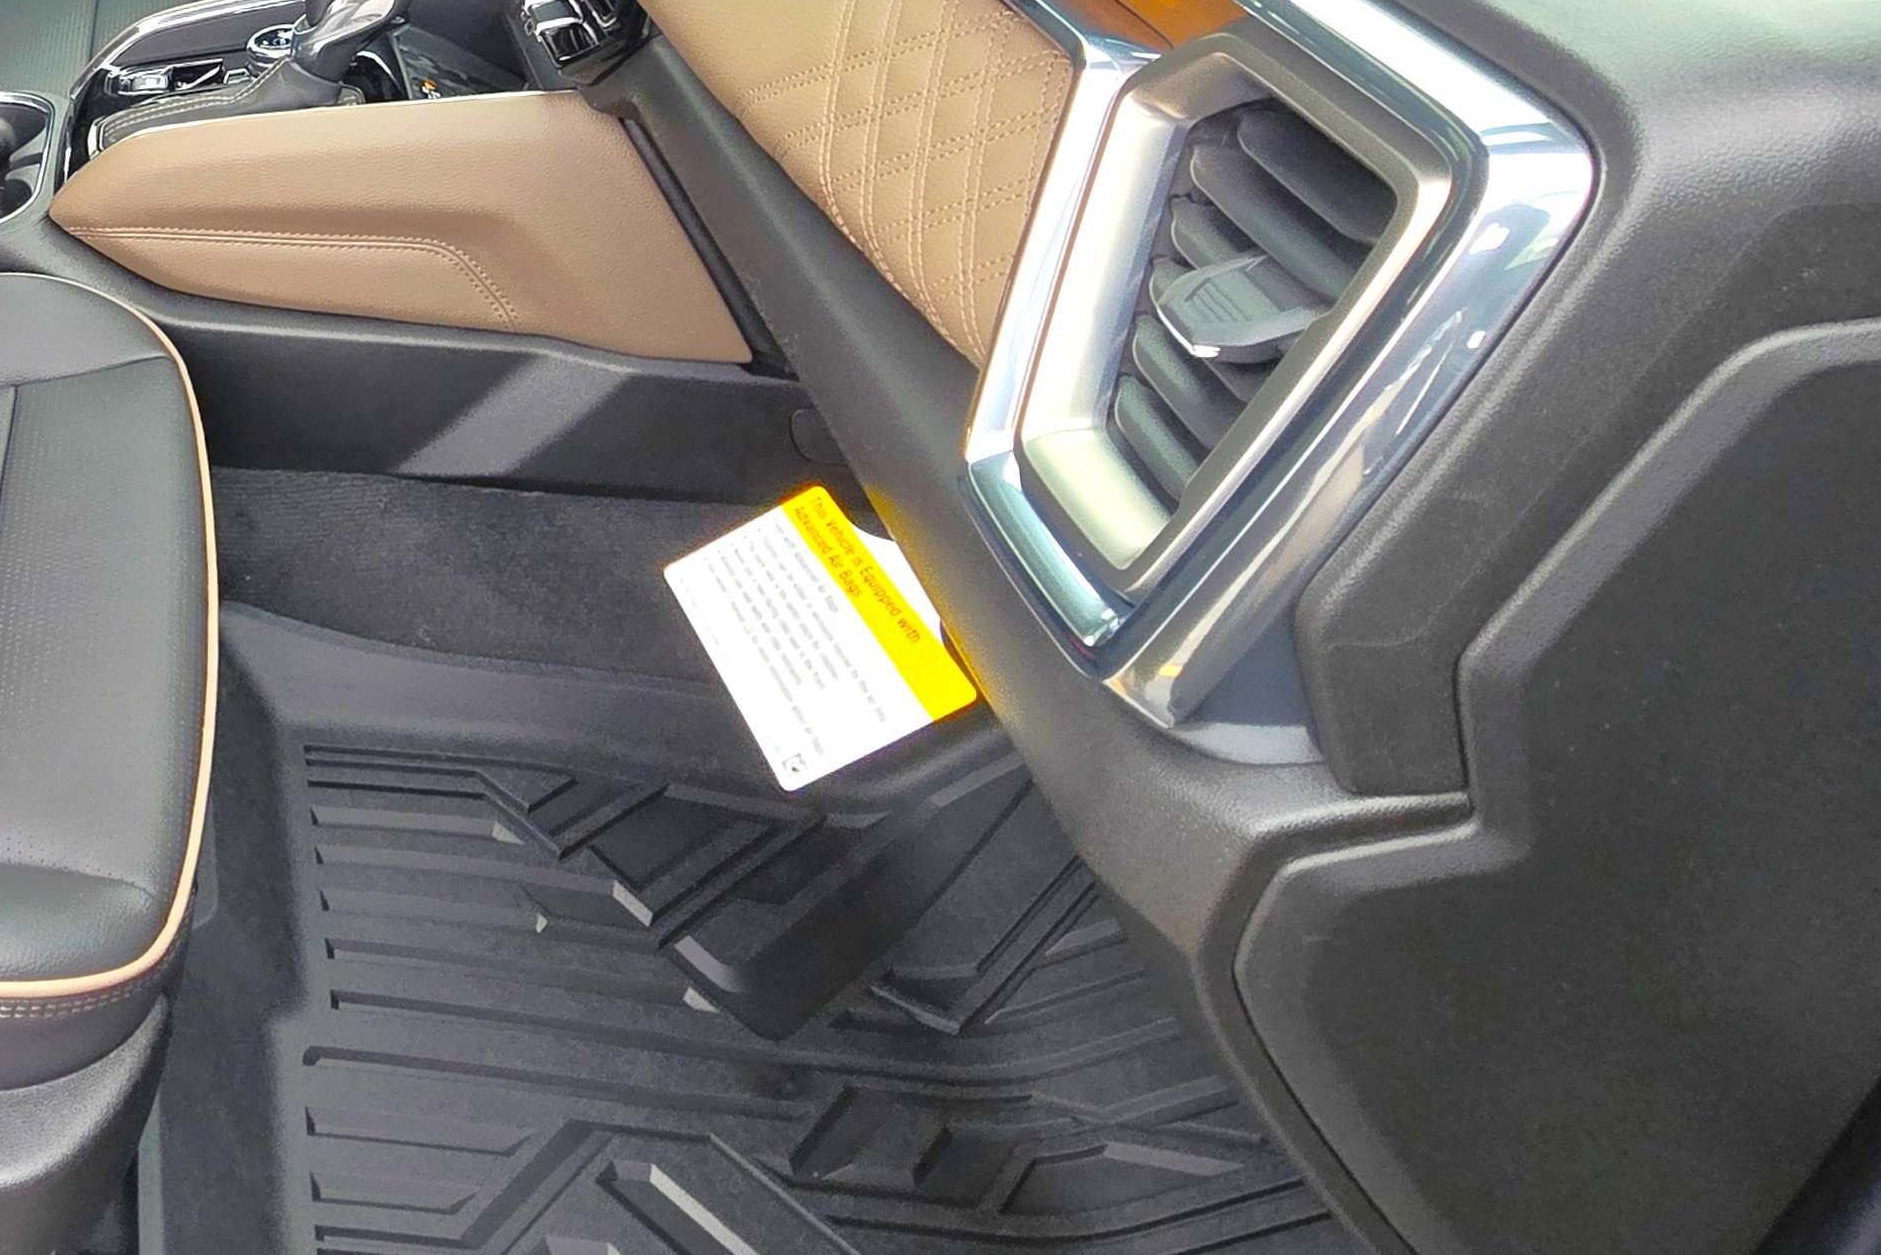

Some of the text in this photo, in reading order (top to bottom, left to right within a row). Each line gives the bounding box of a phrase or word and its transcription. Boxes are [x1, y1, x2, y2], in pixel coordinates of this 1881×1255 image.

[794, 505, 863, 598] Advanced Air Bags
[810, 496, 921, 644] This Vehicle is Equipped with
